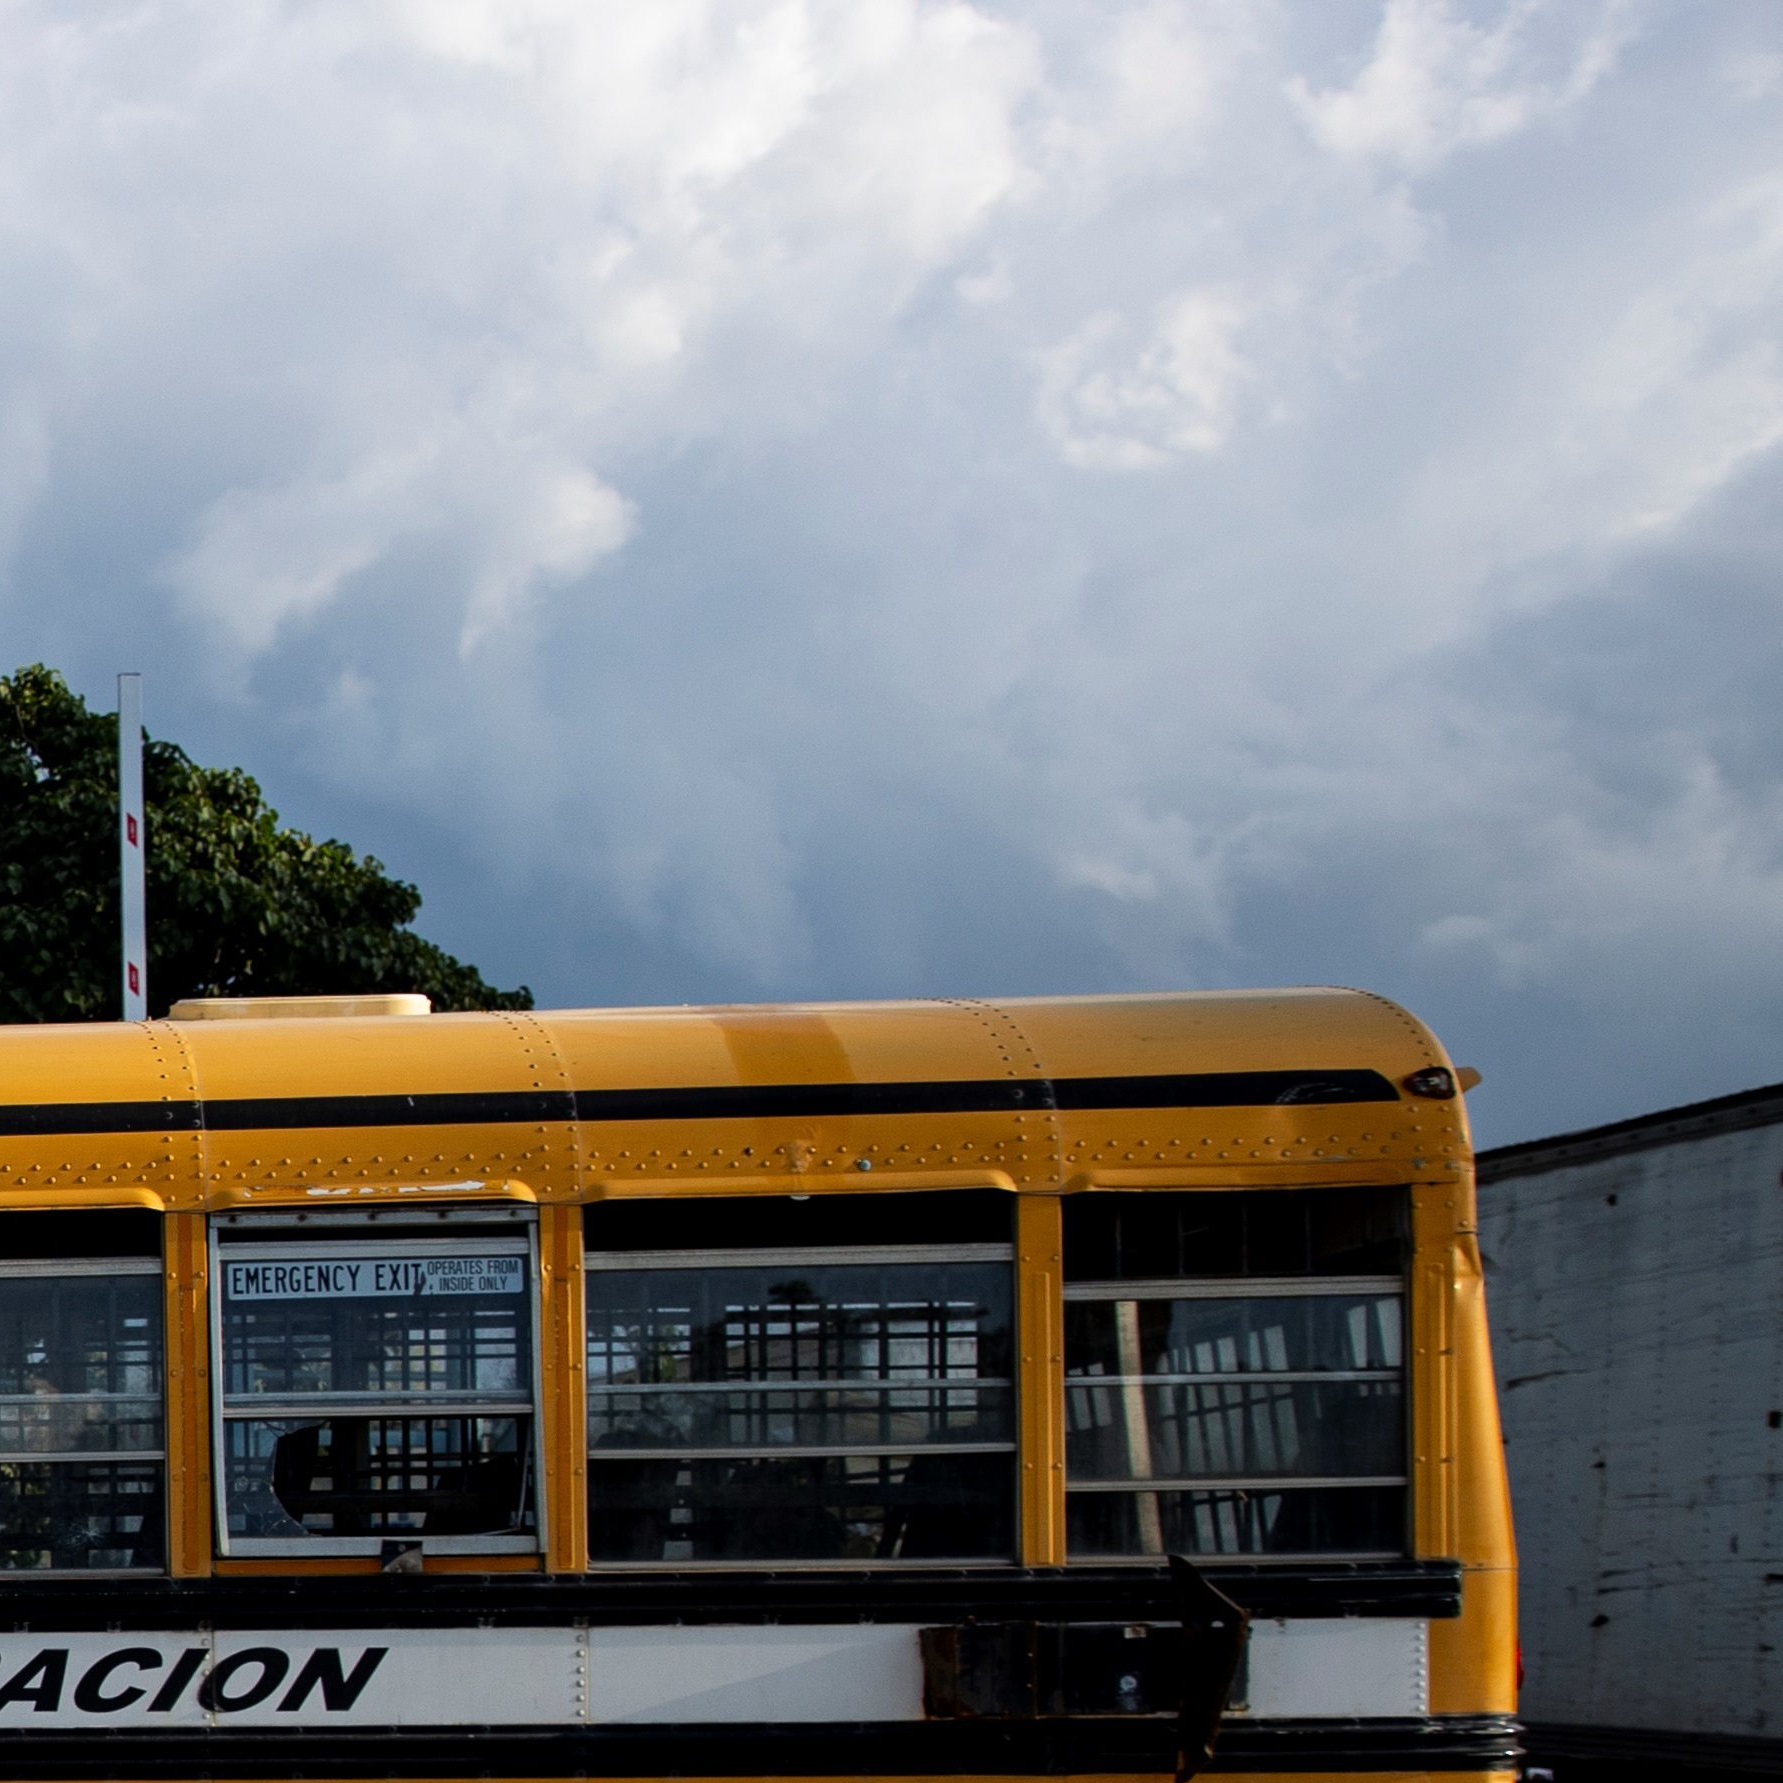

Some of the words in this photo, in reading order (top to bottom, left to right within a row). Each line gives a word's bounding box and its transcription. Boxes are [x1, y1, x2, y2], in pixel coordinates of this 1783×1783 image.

[426, 1259, 484, 1276] OPERATES
[486, 1259, 519, 1275] FROM
[232, 1264, 361, 1295] EMERGENCY
[374, 1262, 423, 1292] EXIT
[438, 1276, 475, 1292] INSIDE
[478, 1275, 508, 1291] ONLY
